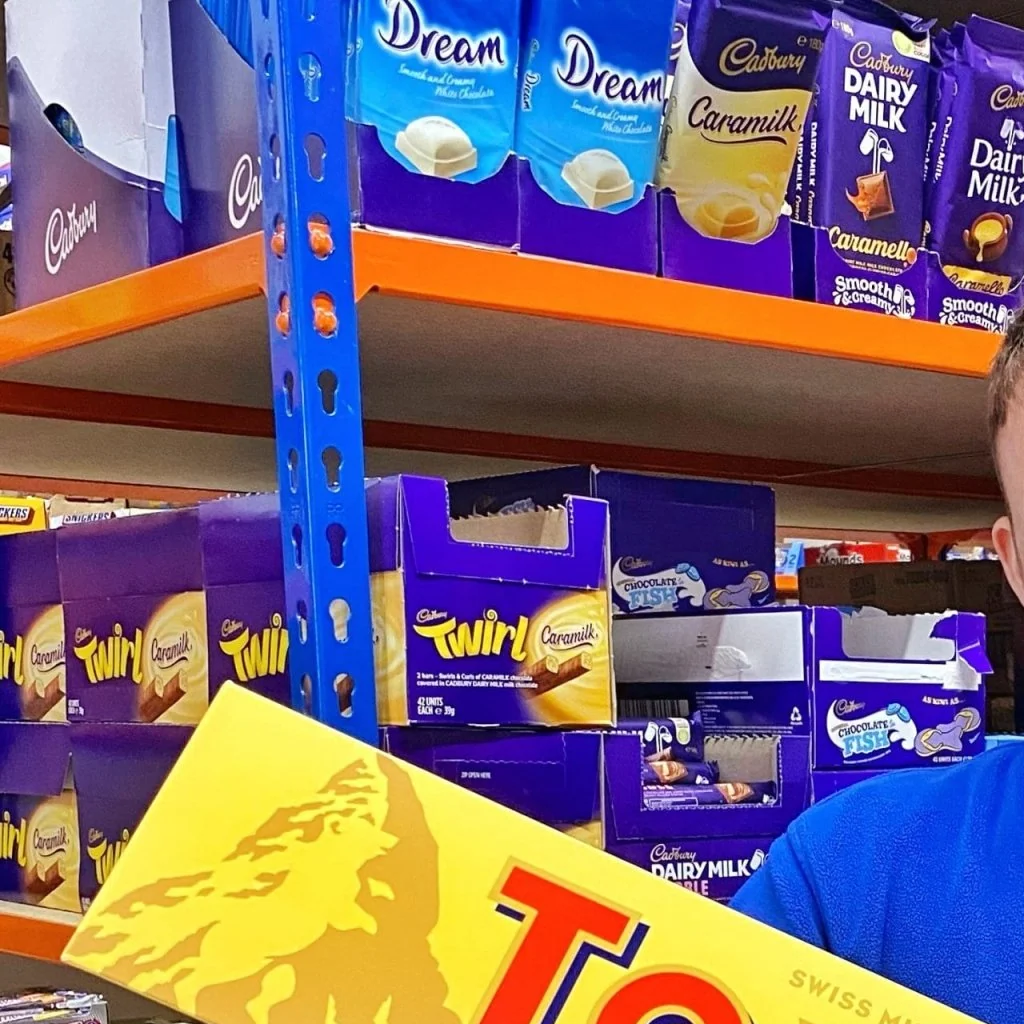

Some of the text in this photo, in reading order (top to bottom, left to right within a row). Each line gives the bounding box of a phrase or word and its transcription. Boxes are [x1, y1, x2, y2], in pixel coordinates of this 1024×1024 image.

[378, 0, 505, 65] Dream
[556, 34, 667, 103] Dream
[719, 38, 806, 76] Cadbury
[850, 41, 914, 82] Cadbury
[844, 67, 918, 106] DAIRY
[688, 96, 799, 134] Caramilk
[849, 95, 907, 133] MILK
[967, 171, 1024, 206] Milk
[45, 200, 97, 275] Cadbury
[834, 275, 896, 299] Smooth
[942, 297, 999, 321] Smooth
[624, 577, 677, 592] CHOCOLATE
[628, 587, 677, 610] FISH
[416, 608, 448, 623] Cadbury
[151, 631, 190, 662] Caramilk
[413, 609, 529, 662] Twirl
[541, 622, 596, 648] Caramilk
[74, 623, 143, 684] Twirl
[417, 697, 443, 706] 42 UNITS
[418, 706, 455, 716] EACH 39g
[838, 719, 889, 737] CHOCOLATE
[843, 730, 891, 758] FISH
[650, 843, 696, 863] Cadbury
[651, 859, 750, 881] DAIRY MILK
[789, 969, 871, 1019] SWISS
